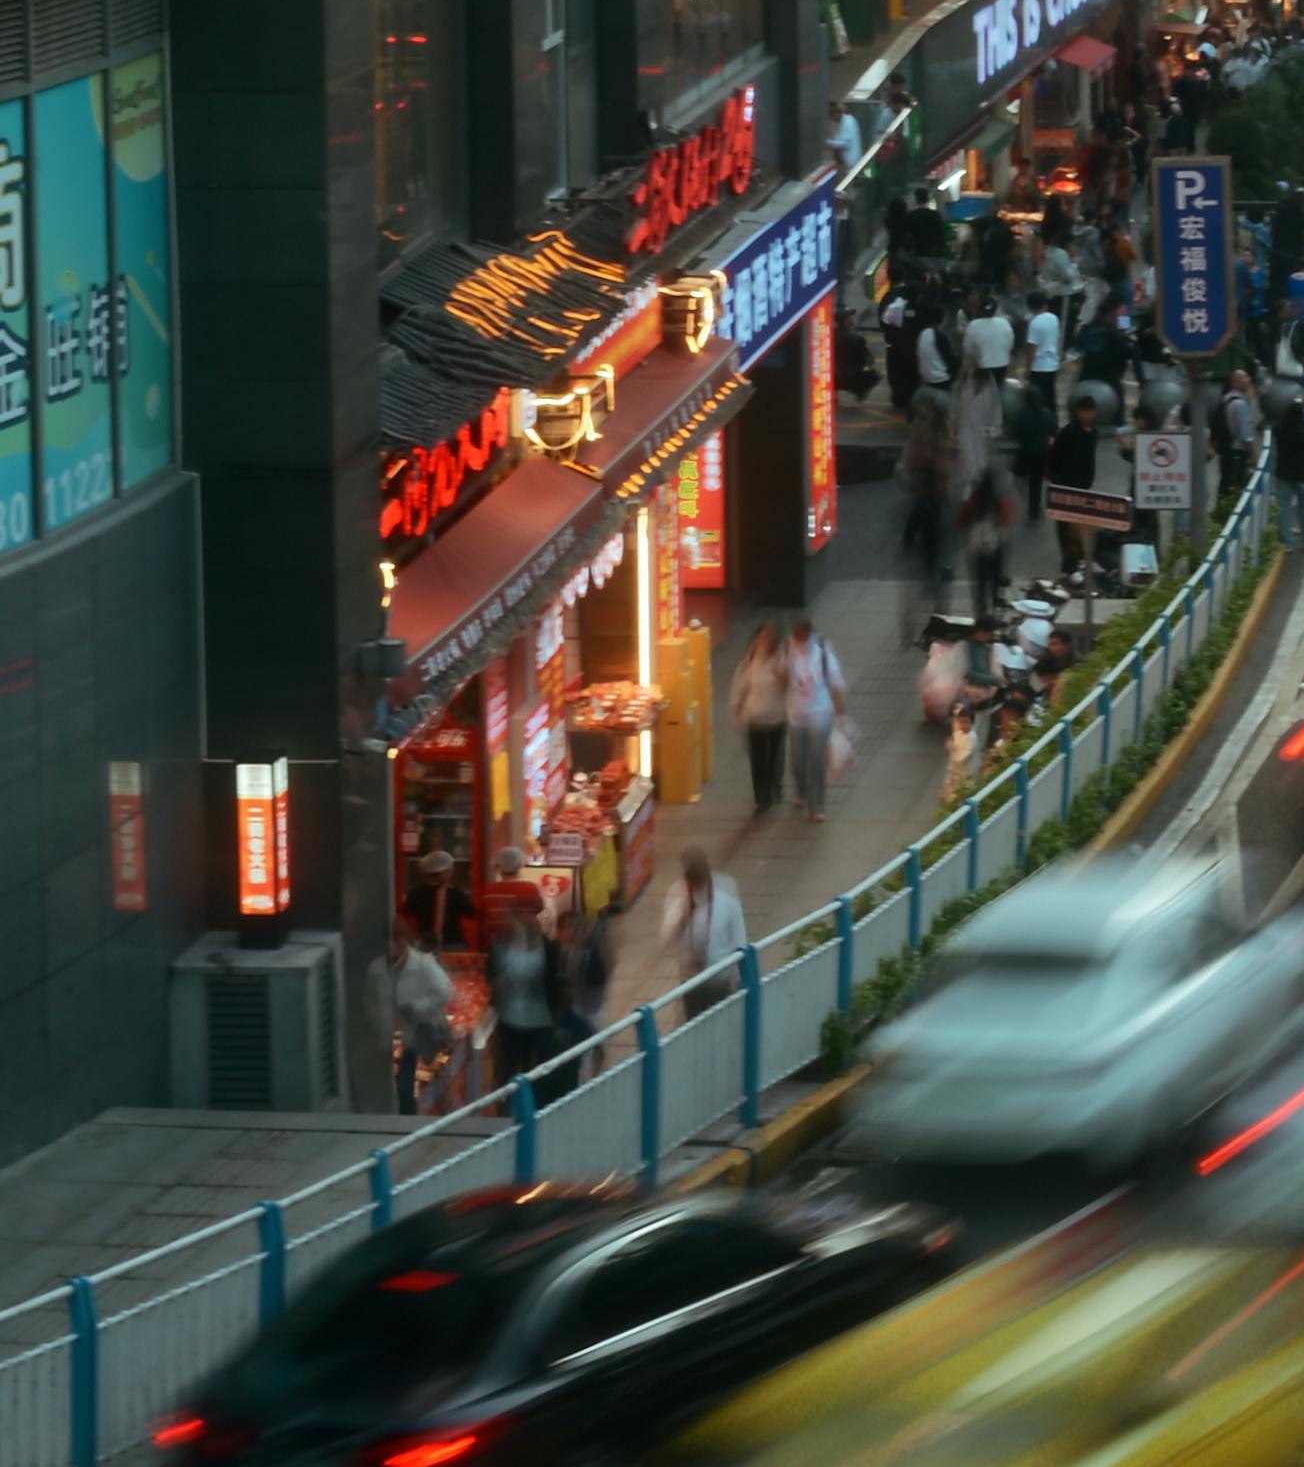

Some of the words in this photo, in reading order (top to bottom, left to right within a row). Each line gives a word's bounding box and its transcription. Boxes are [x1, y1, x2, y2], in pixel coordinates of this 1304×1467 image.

[1175, 170, 1206, 210] P
[1178, 216, 1210, 334] 宏福俊悦
